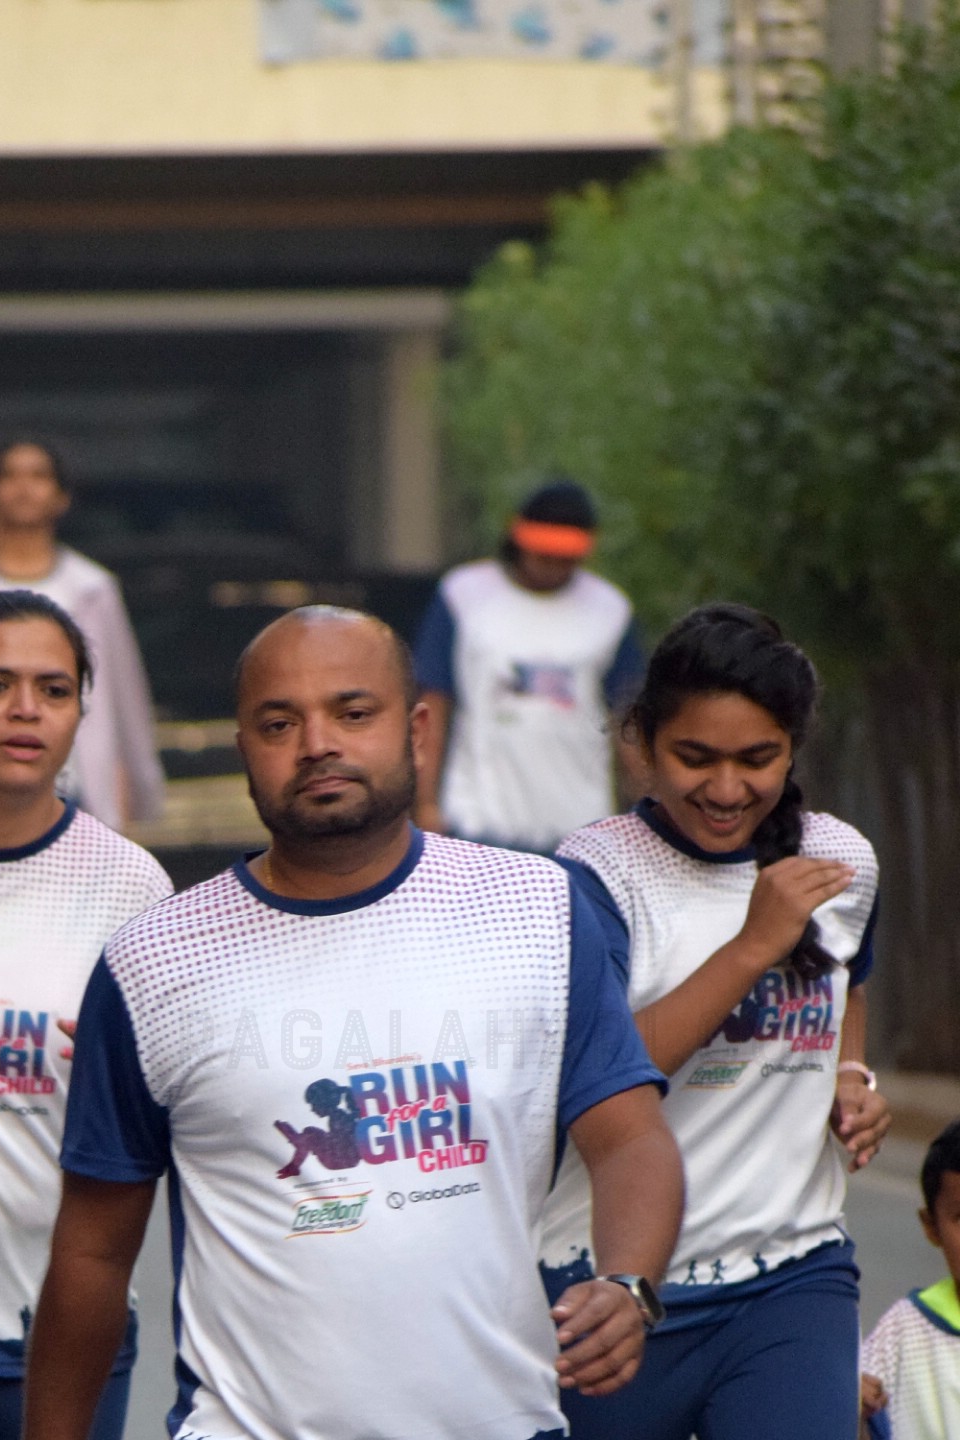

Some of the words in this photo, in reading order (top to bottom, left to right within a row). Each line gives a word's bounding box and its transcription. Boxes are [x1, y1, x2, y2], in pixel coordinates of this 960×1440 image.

[754, 1004, 836, 1040] GIRL
[349, 1060, 471, 1117] RUN
[386, 1100, 427, 1133] for
[432, 1095, 447, 1113] a
[356, 1104, 488, 1165] GIRL
[418, 1143, 487, 1173] CHILD
[408, 1182, 481, 1202] GlobalData
